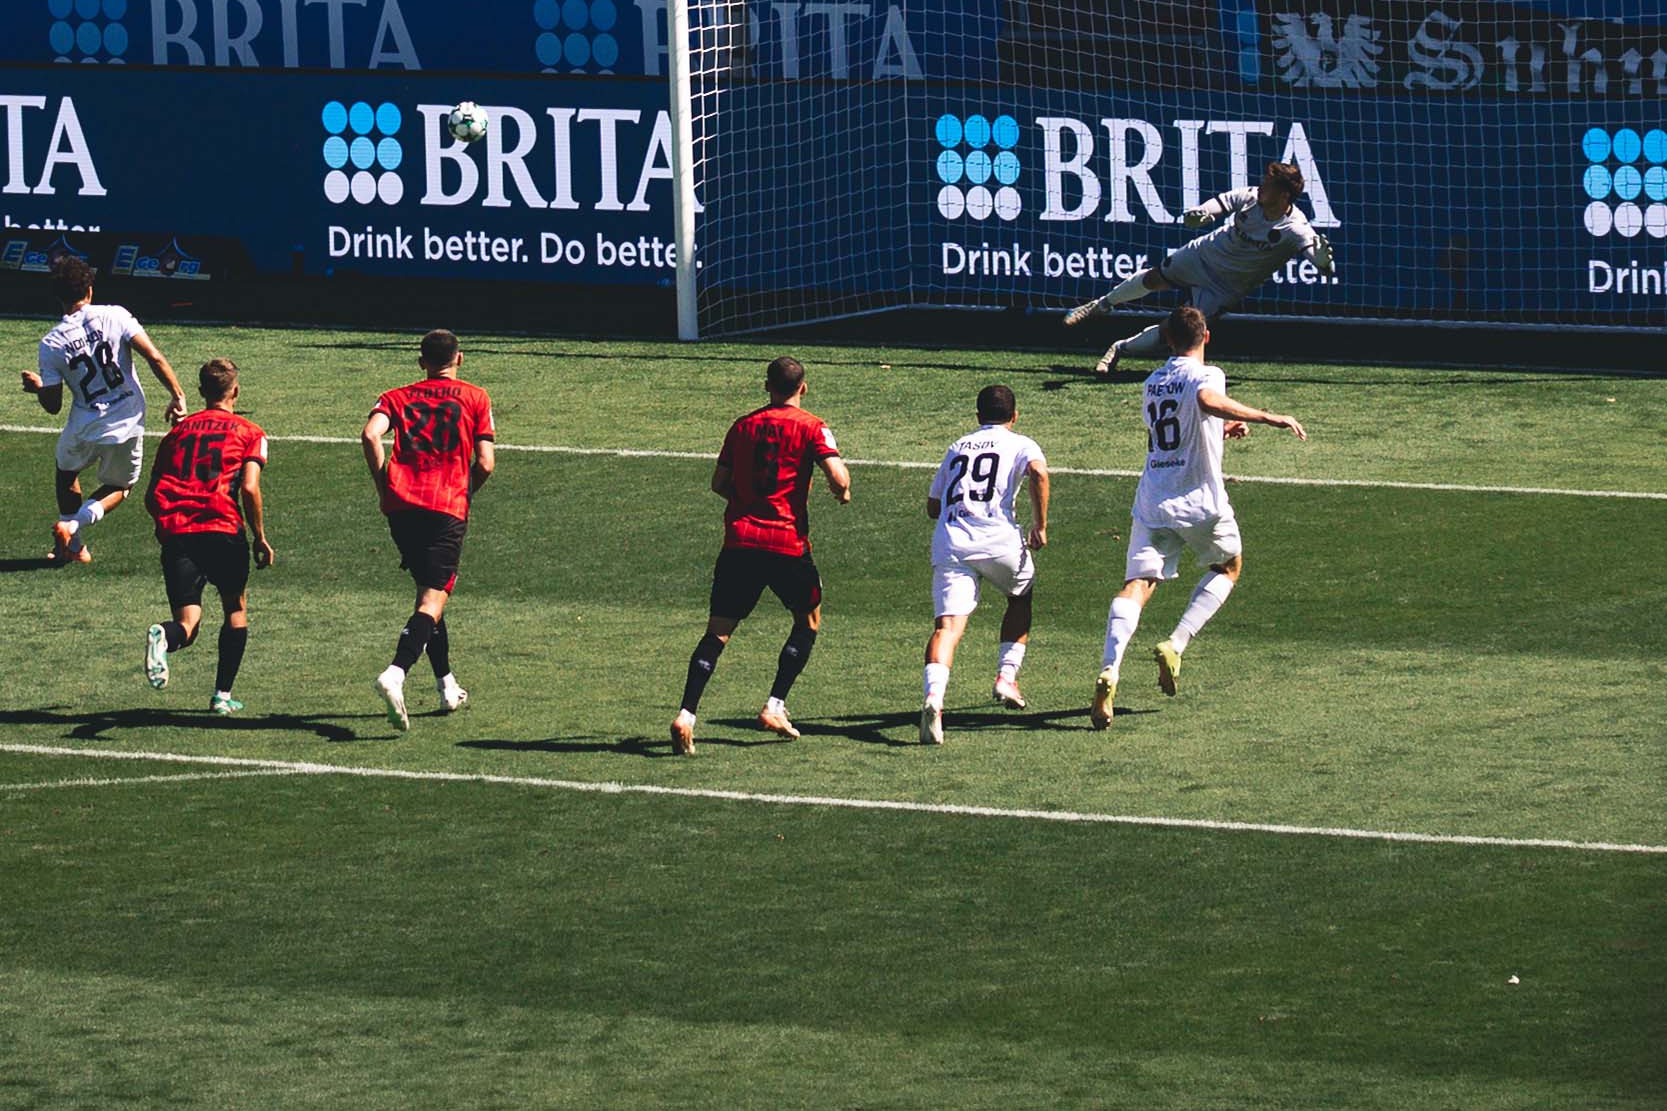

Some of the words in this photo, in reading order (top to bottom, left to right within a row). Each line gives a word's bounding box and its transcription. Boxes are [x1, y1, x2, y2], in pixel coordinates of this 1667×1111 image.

[416, 104, 705, 213] BRITA
[1035, 116, 1342, 228] BRITA
[328, 226, 413, 259] Drink
[424, 228, 528, 263] better.
[540, 232, 585, 265] Do
[597, 234, 703, 268] bette.
[942, 242, 1033, 277] Drink
[1590, 259, 1667, 296] Drin
[403, 401, 462, 452] 28
[1147, 399, 1180, 453] 16
[178, 434, 227, 483] 15
[946, 452, 1000, 507] 29
